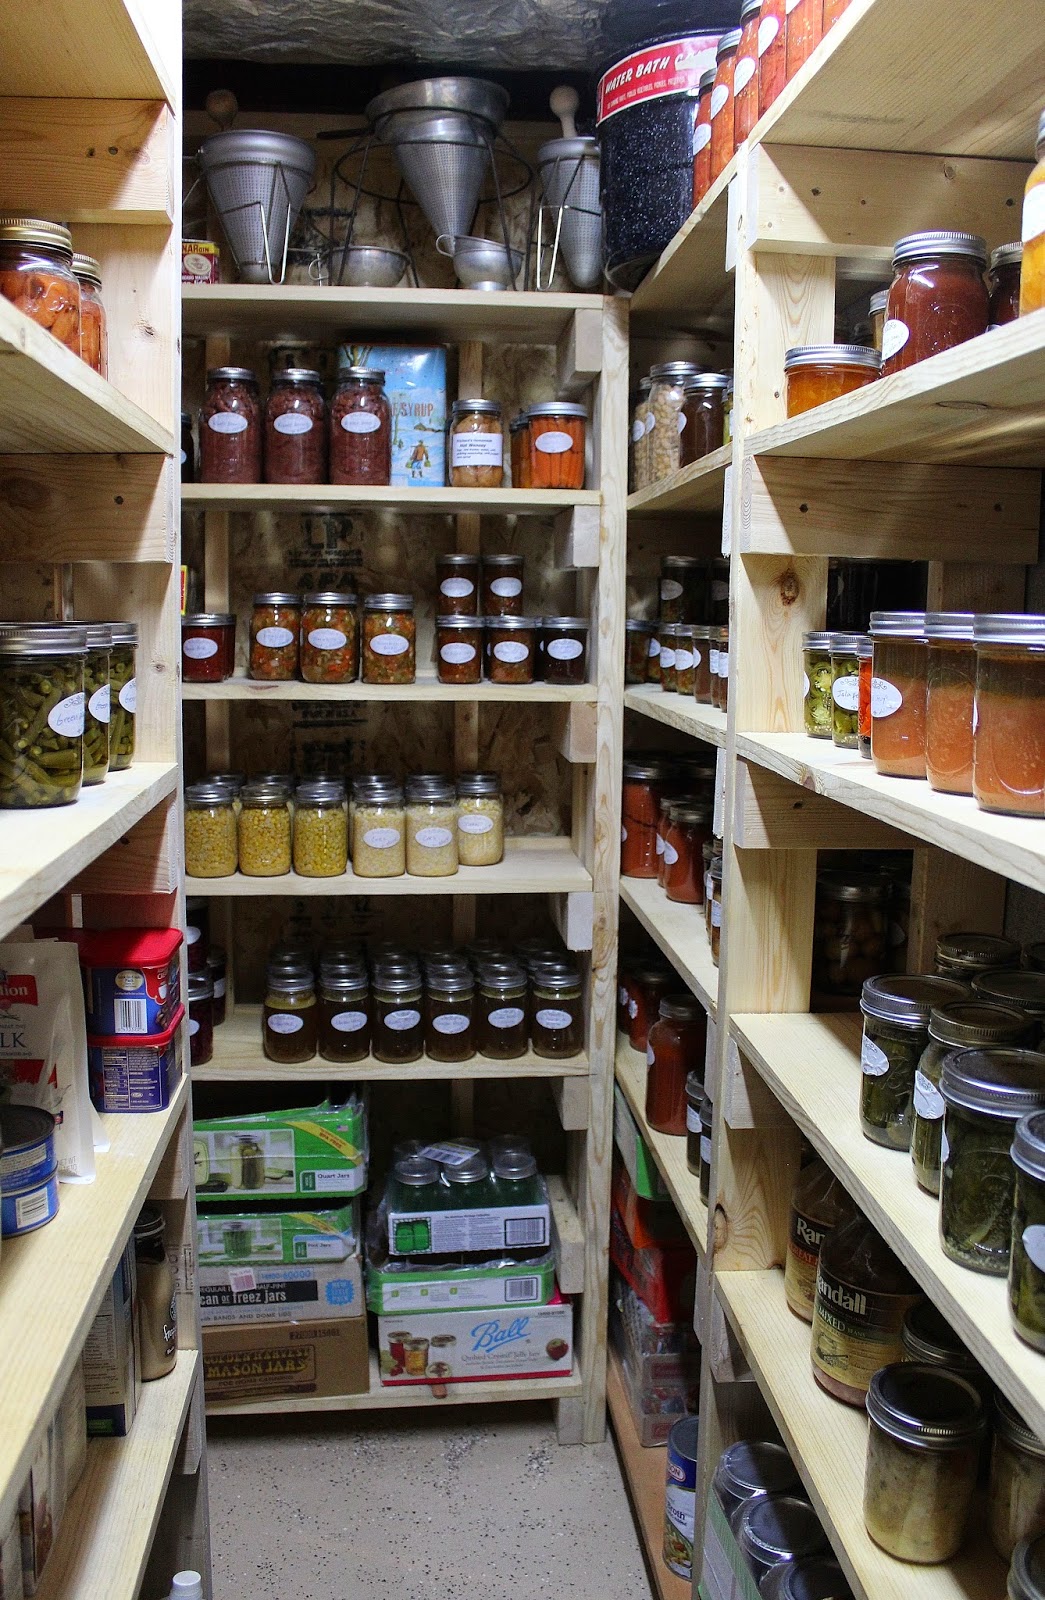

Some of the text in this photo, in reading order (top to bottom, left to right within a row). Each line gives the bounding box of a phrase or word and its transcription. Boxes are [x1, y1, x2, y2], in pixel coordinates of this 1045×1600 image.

[605, 68, 634, 94] WATER
[635, 56, 671, 79] BATH
[400, 402, 434, 417] SYRUP
[0, 1032, 27, 1048] LK
[264, 1290, 287, 1304] jars
[818, 1275, 867, 1315] andall
[818, 1305, 846, 1331] MIXED
[470, 1316, 531, 1354] Ball
[207, 1358, 309, 1378] MASON JARS
